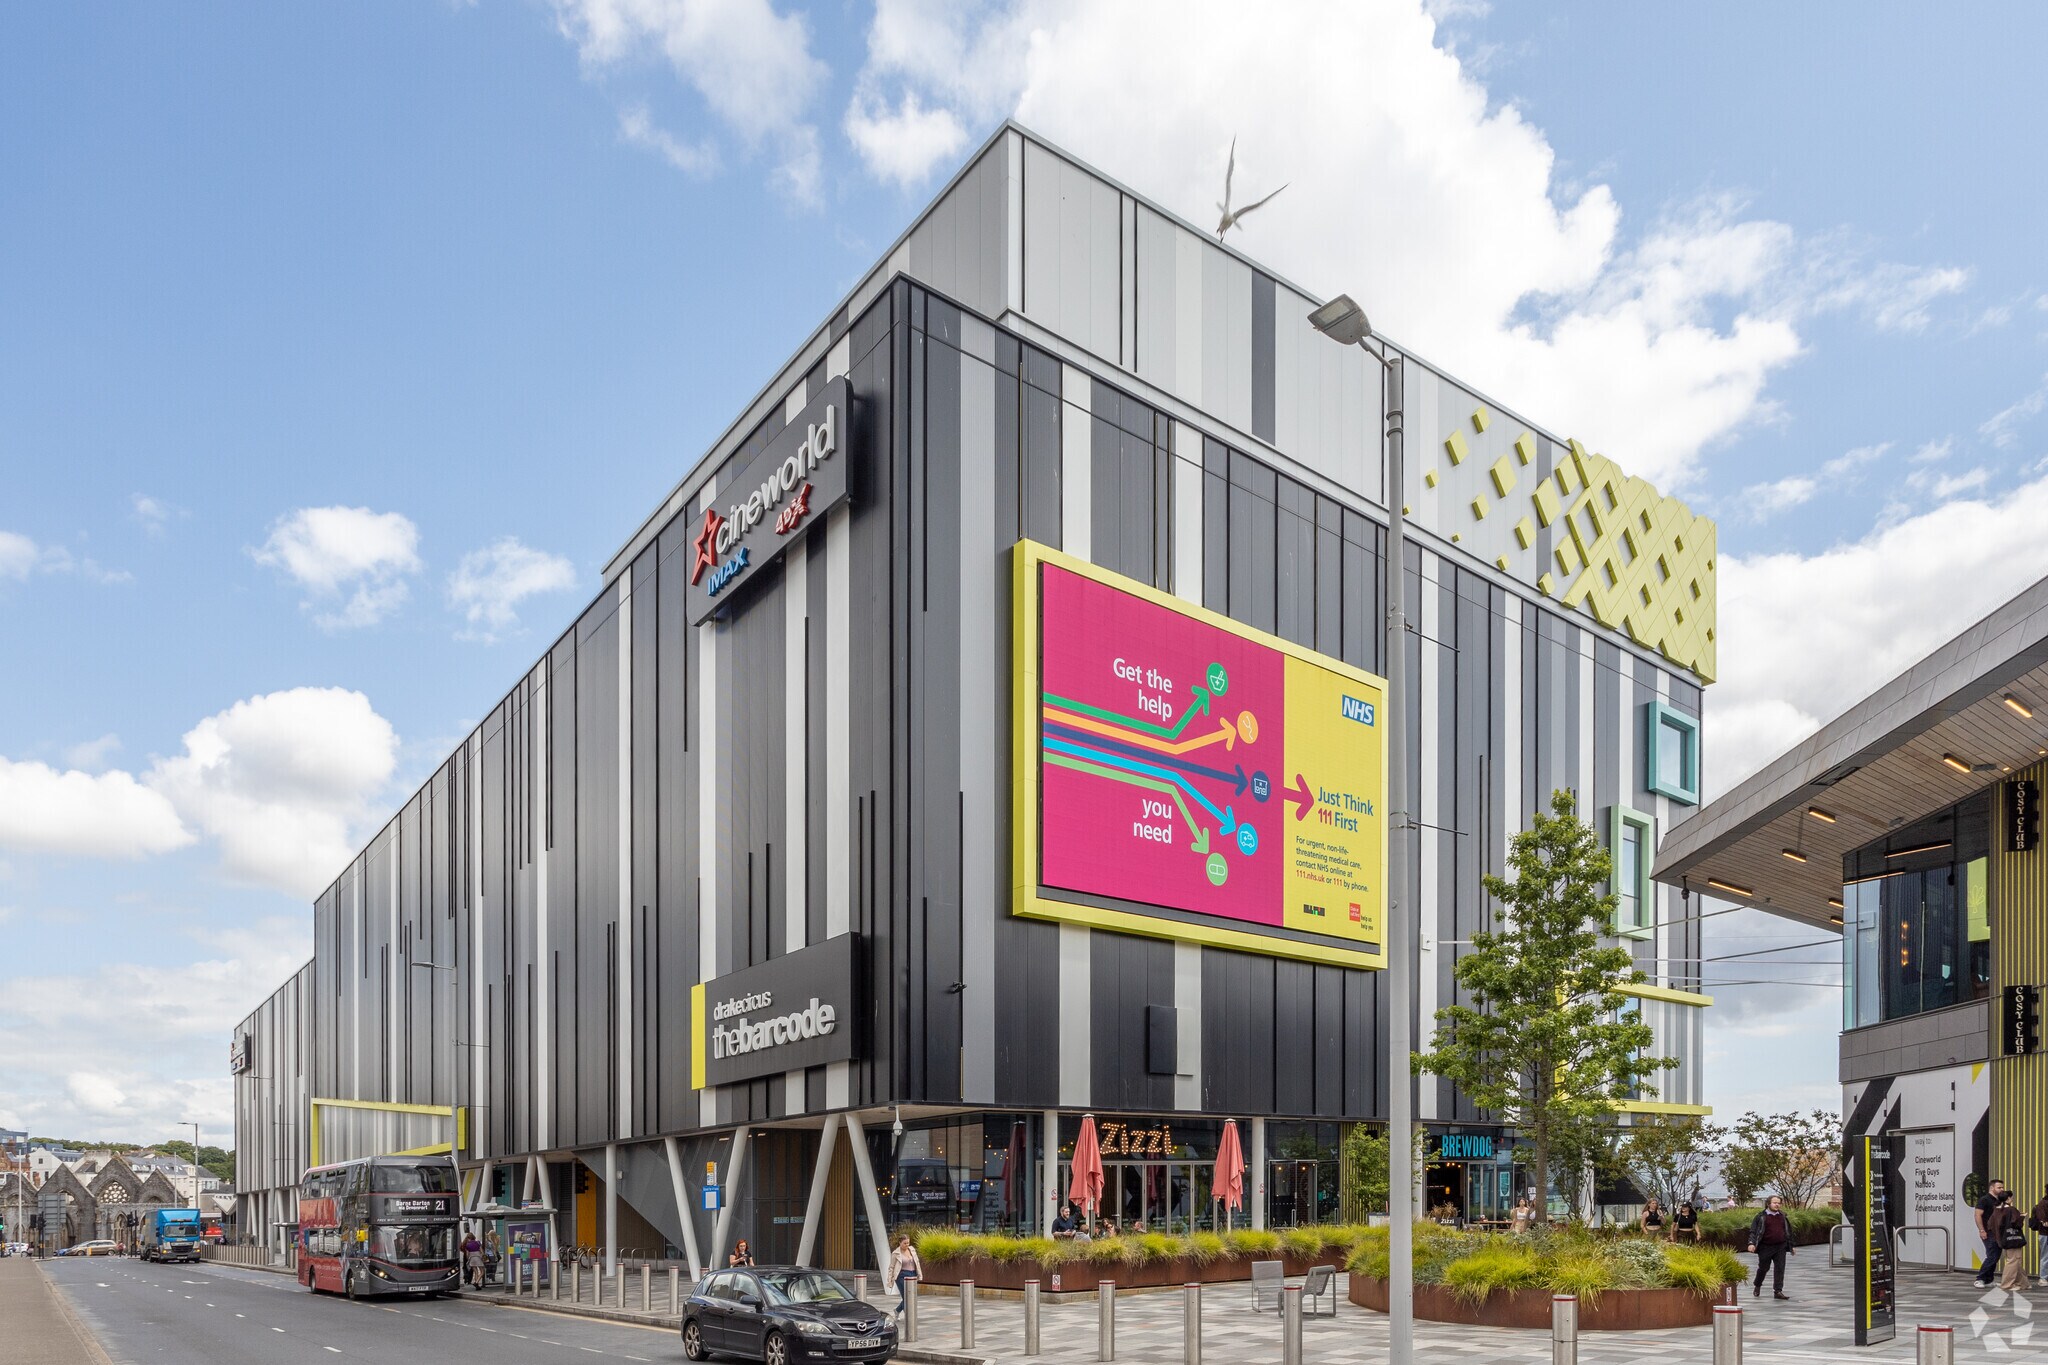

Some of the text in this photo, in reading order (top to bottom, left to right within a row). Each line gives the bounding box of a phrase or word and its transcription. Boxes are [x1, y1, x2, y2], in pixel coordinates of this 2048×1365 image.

[715, 404, 834, 554] cineworld
[707, 546, 750, 597] IMAX
[1113, 657, 1173, 694] Get the
[1138, 689, 1173, 722] help
[1342, 696, 1374, 725] NHS
[1142, 798, 1173, 820] you
[1318, 786, 1374, 817] Just Think
[1317, 807, 1359, 833] 111 First
[2015, 781, 2026, 850] COSY CLUB
[1133, 821, 1173, 845] need
[1295, 835, 1349, 856] For urgent, non-life-
[1295, 847, 1328, 864] threatening
[1328, 855, 1349, 867] medical
[1295, 859, 1353, 879] contact NHS online at
[1296, 869, 1325, 883] 111.nhs.uk
[1333, 877, 1343, 887] 111
[1343, 880, 1351, 890] by
[1351, 882, 1369, 893] phone.
[712, 997, 836, 1060] thebarcode
[2014, 986, 2025, 1054] COSY CLUB
[1099, 1122, 1176, 1155] Zizzi
[1441, 1135, 1493, 1158] BREWDOG
[1914, 1154, 1942, 1164] Cineworld
[1914, 1168, 1940, 1178] Five Guys
[435, 1200, 445, 1210] 21
[1914, 1192, 1938, 1201] Paradise
[1914, 1204, 1942, 1213] Adventure
